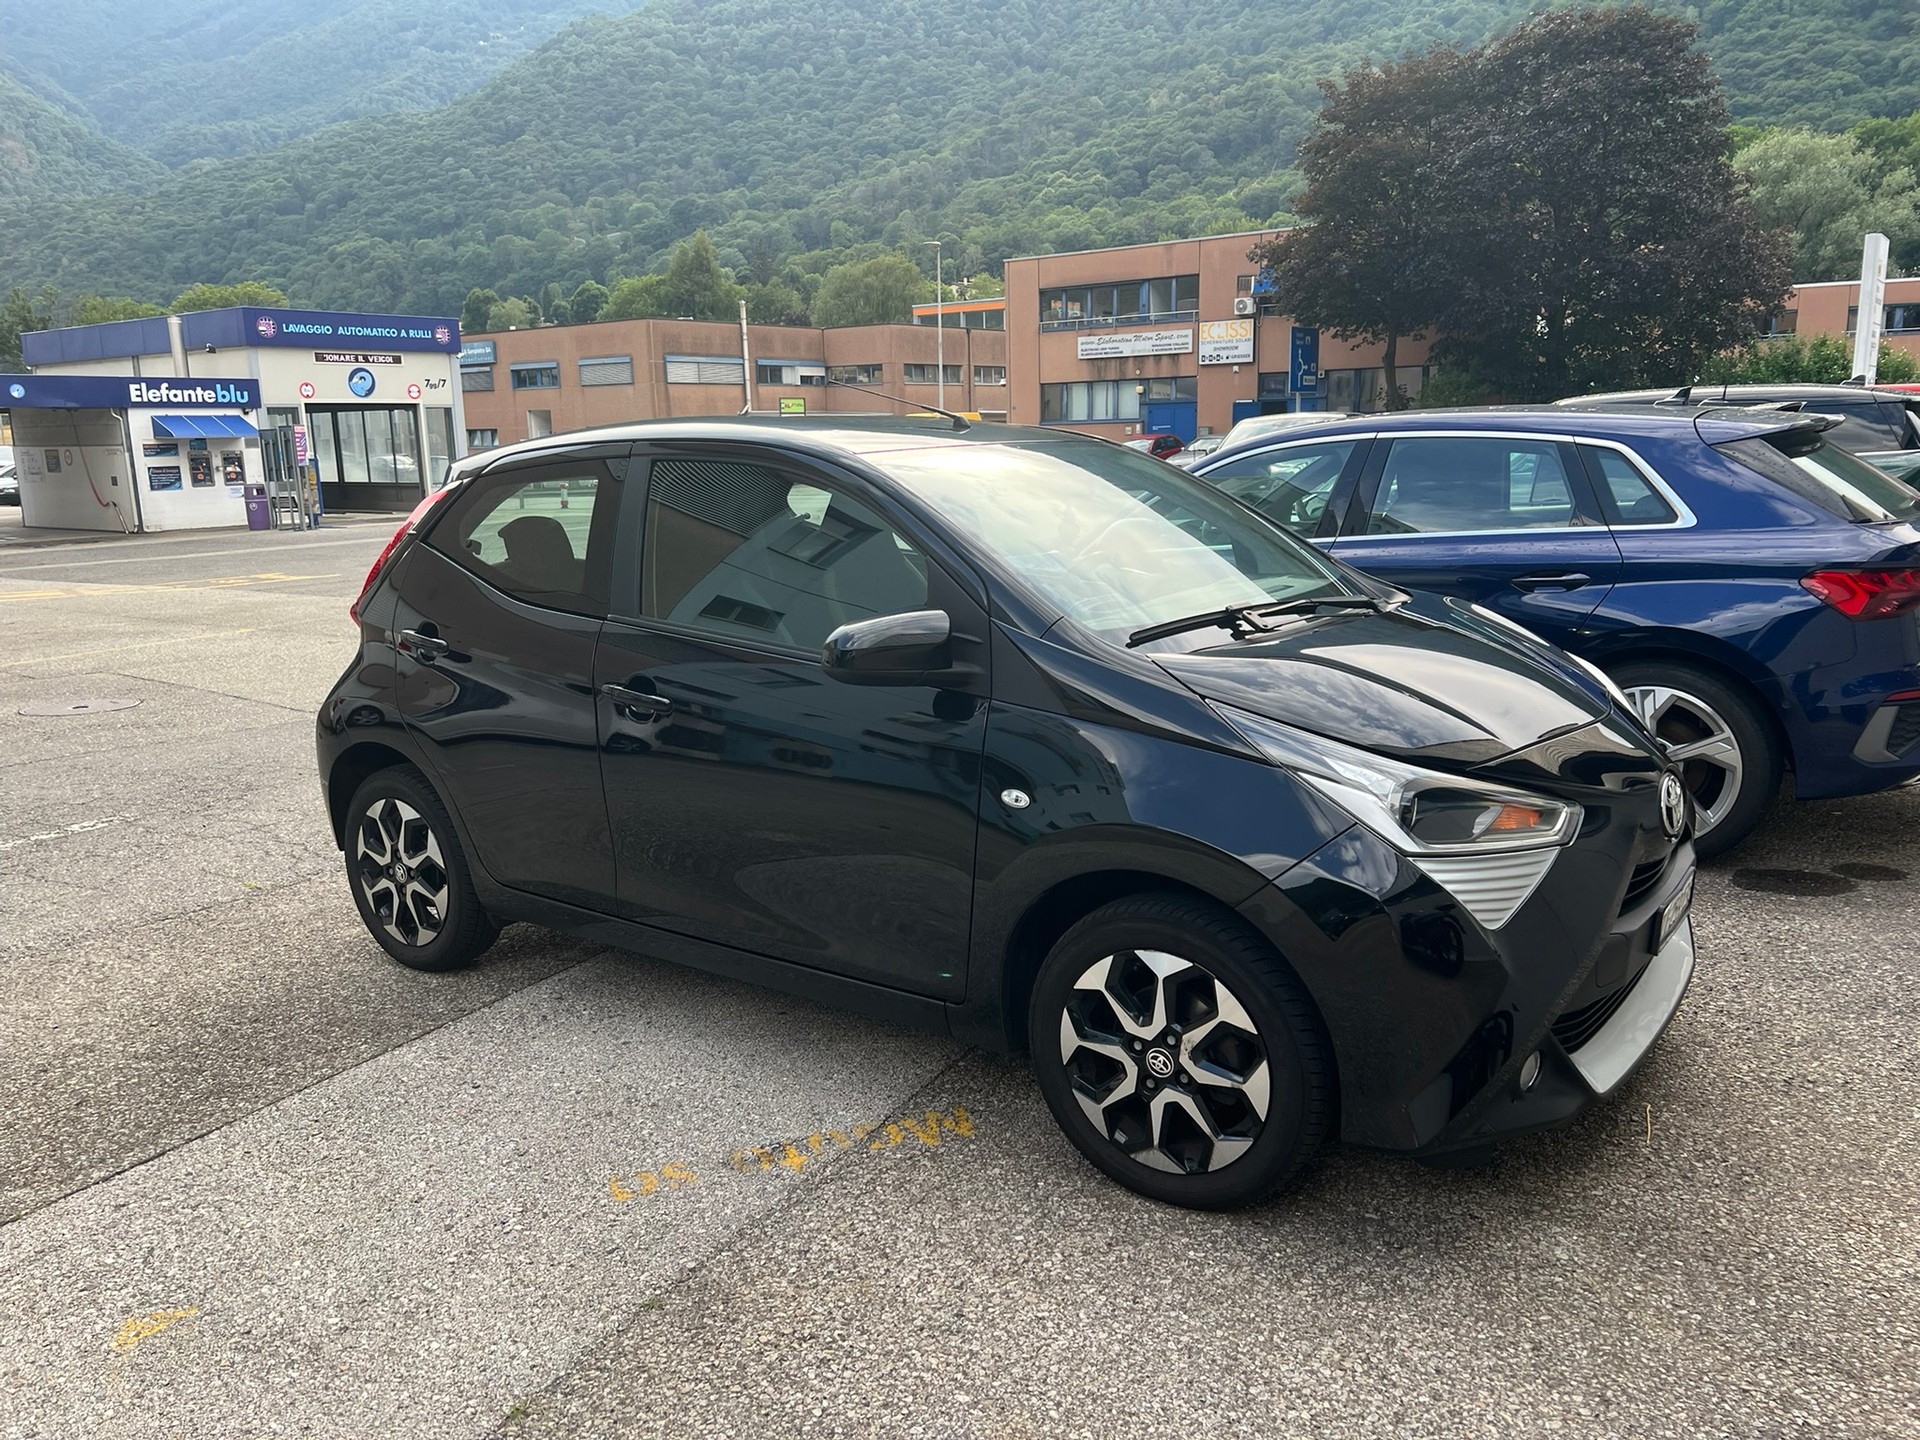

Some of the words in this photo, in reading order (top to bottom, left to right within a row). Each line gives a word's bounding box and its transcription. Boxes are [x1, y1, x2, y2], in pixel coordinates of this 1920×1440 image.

[282, 323, 332, 335] LAVAGGIO
[337, 326, 398, 338] AUTOMATICO
[400, 329, 407, 338] A
[409, 329, 432, 339] RULLI
[129, 382, 249, 403] Elefanteblu
